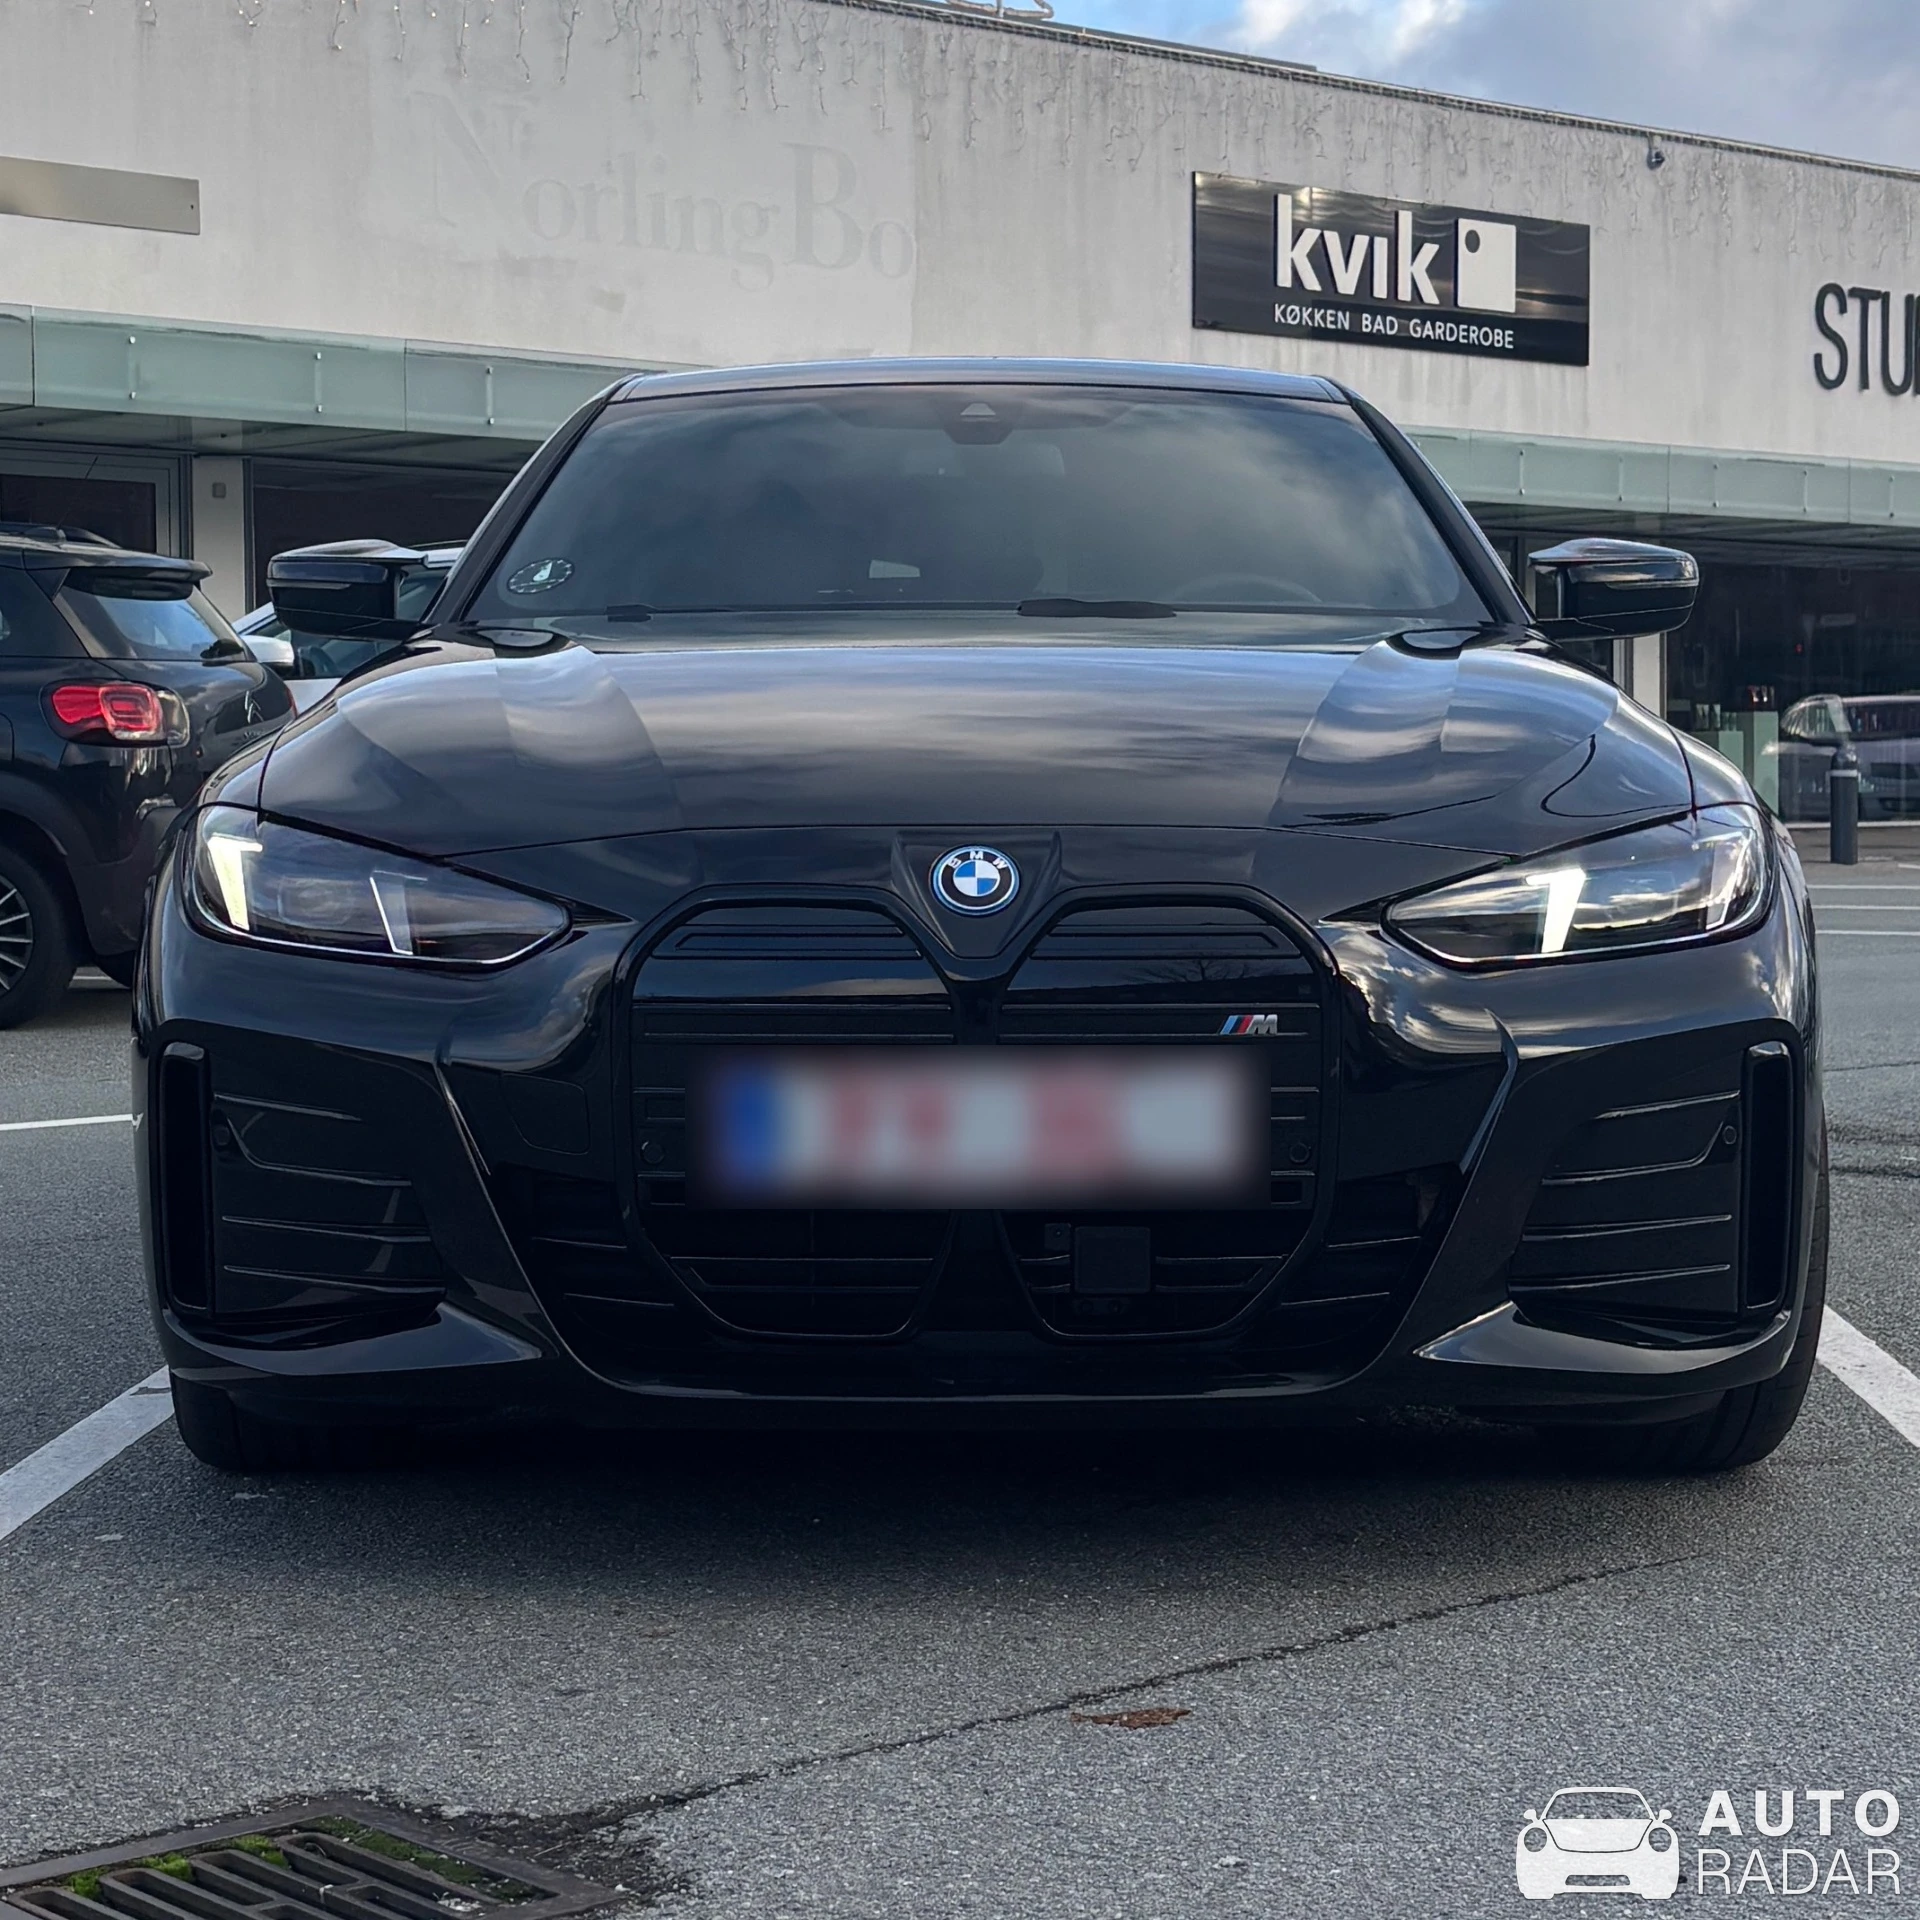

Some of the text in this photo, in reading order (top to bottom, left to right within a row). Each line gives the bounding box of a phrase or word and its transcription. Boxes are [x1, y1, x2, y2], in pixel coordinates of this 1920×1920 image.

[1276, 193, 1440, 305] kvik
[1274, 303, 1514, 349] KØKKEN BAD GARDEROBE
[1814, 282, 1920, 397] STU
[946, 850, 1008, 869] BMW
